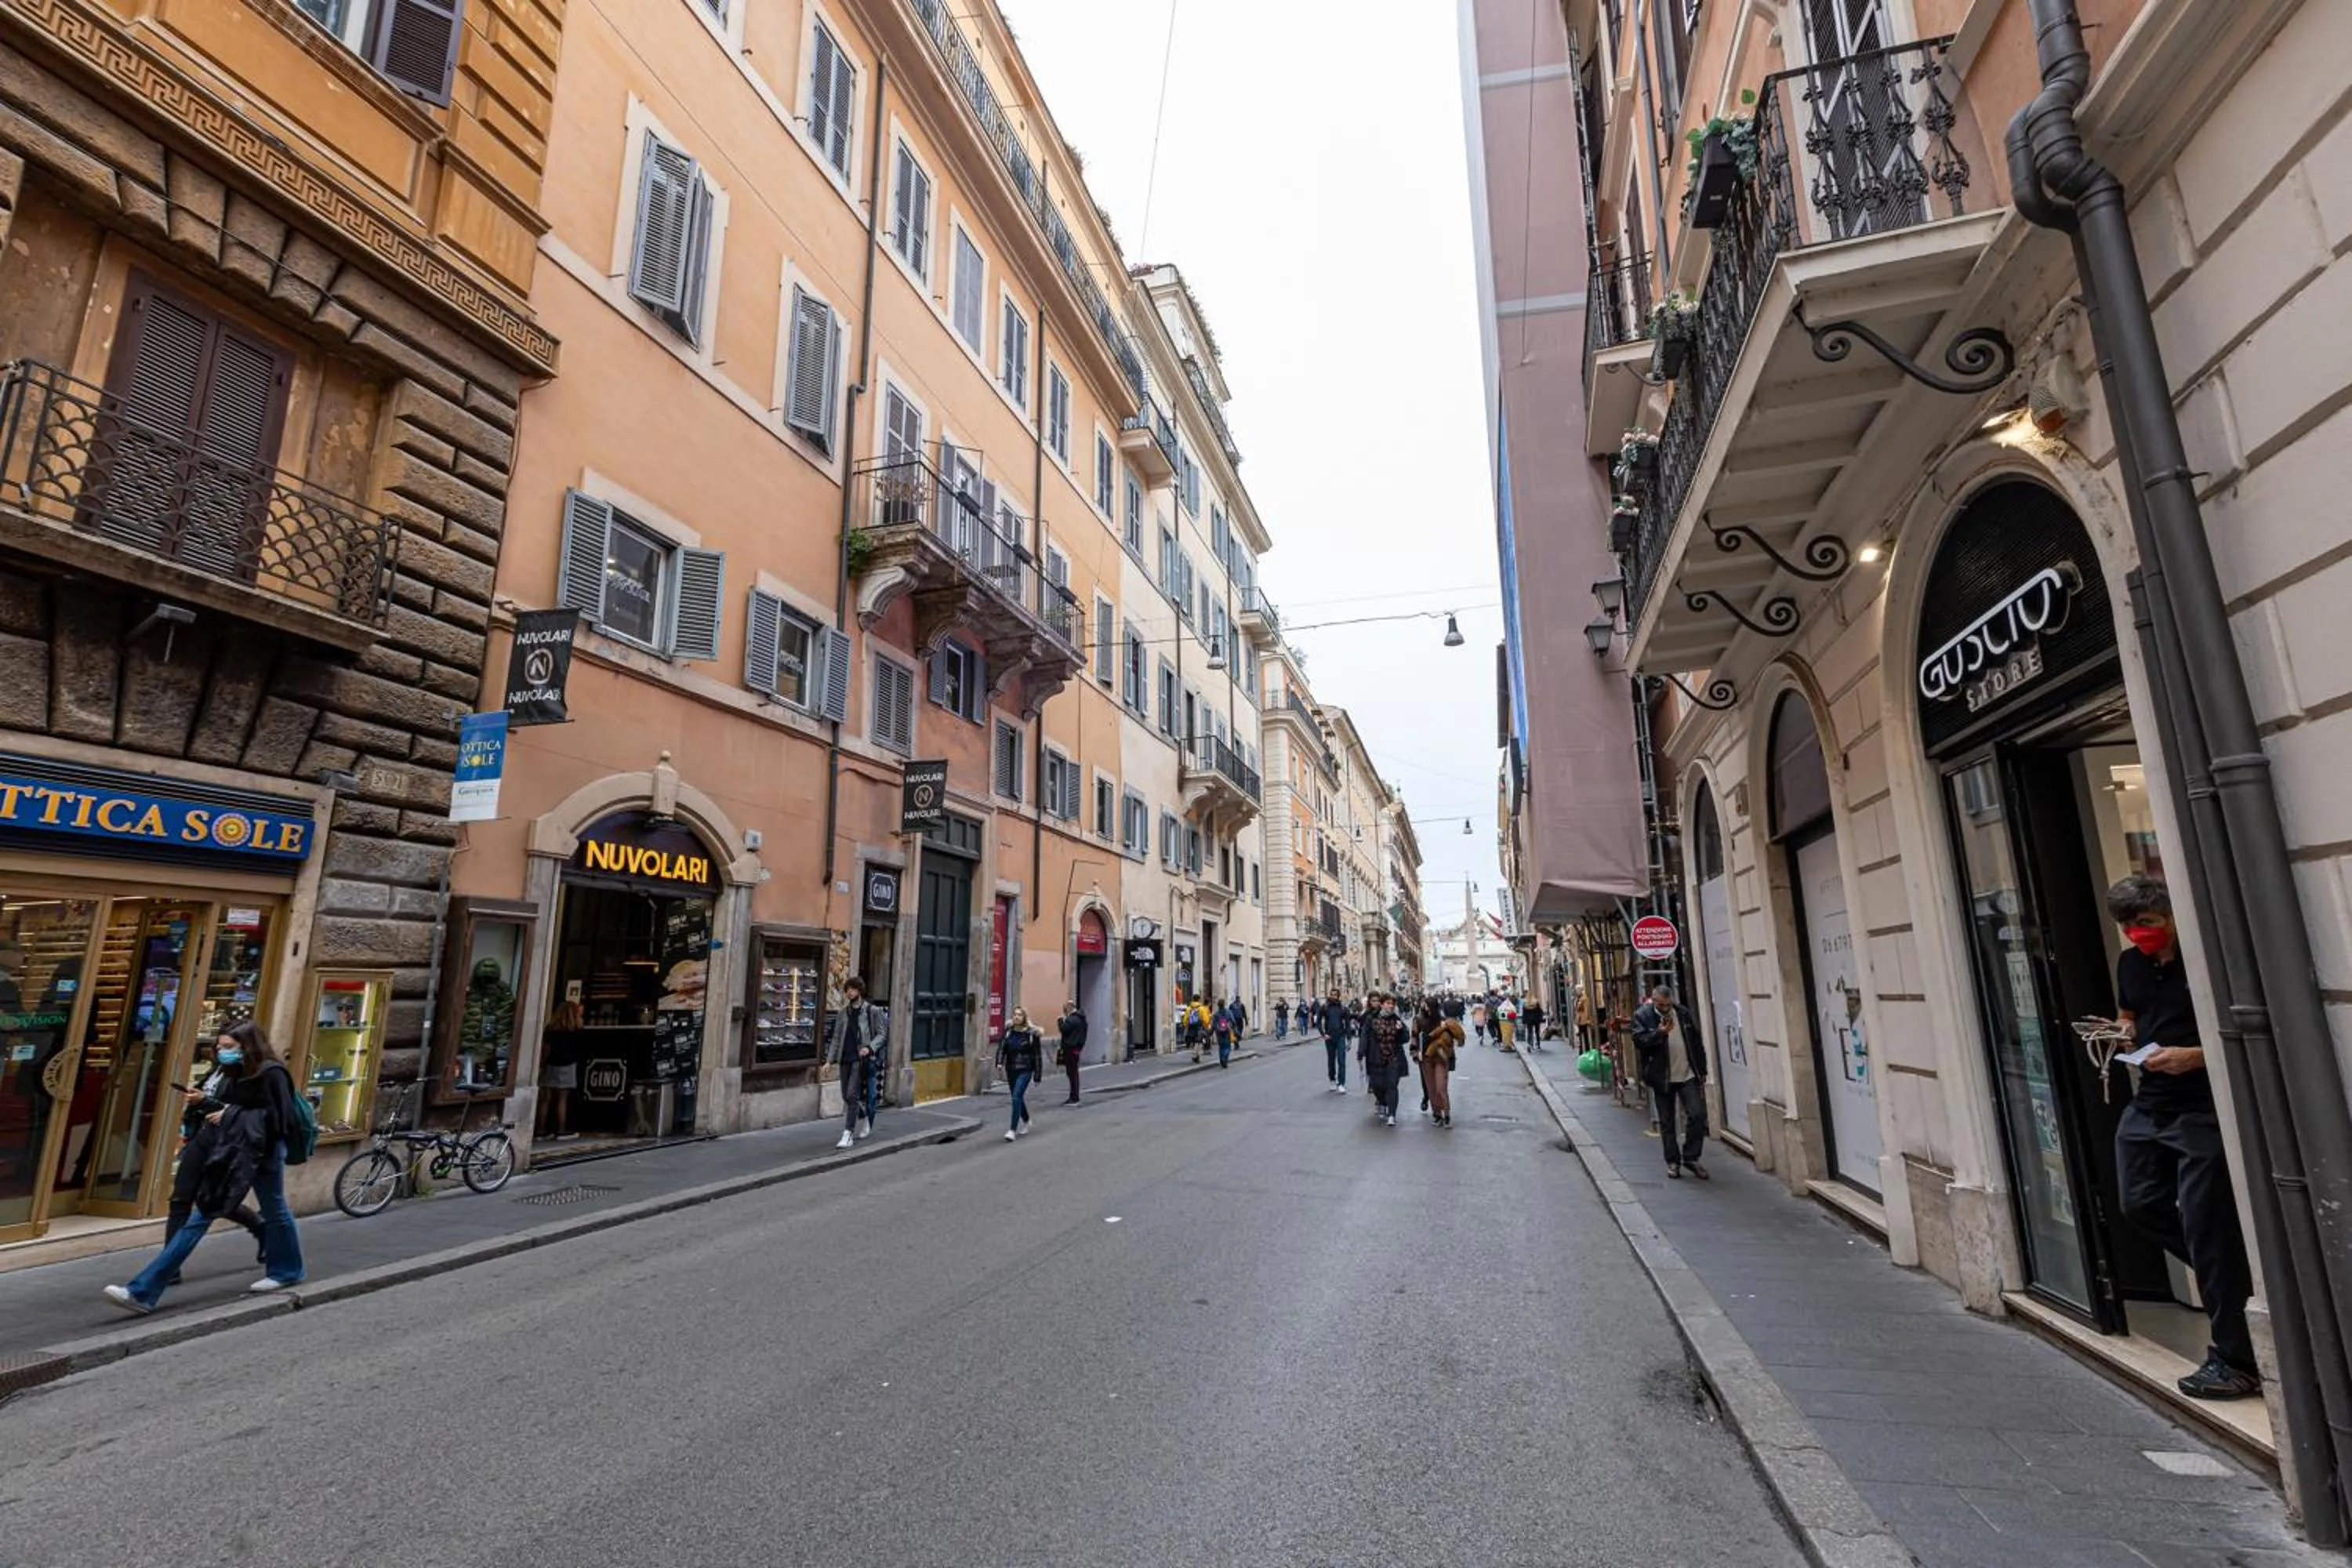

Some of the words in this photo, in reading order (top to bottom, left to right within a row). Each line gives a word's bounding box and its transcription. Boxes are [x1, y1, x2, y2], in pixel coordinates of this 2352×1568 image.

[517, 629, 572, 644] NUVOLARI
[1966, 648, 2042, 708] STORE
[461, 739, 502, 753] OTTICA
[463, 753, 496, 768] SOLE
[180, 810, 305, 853] SOLE
[586, 840, 709, 884] NUVOLARI
[590, 1070, 620, 1087] GINO
